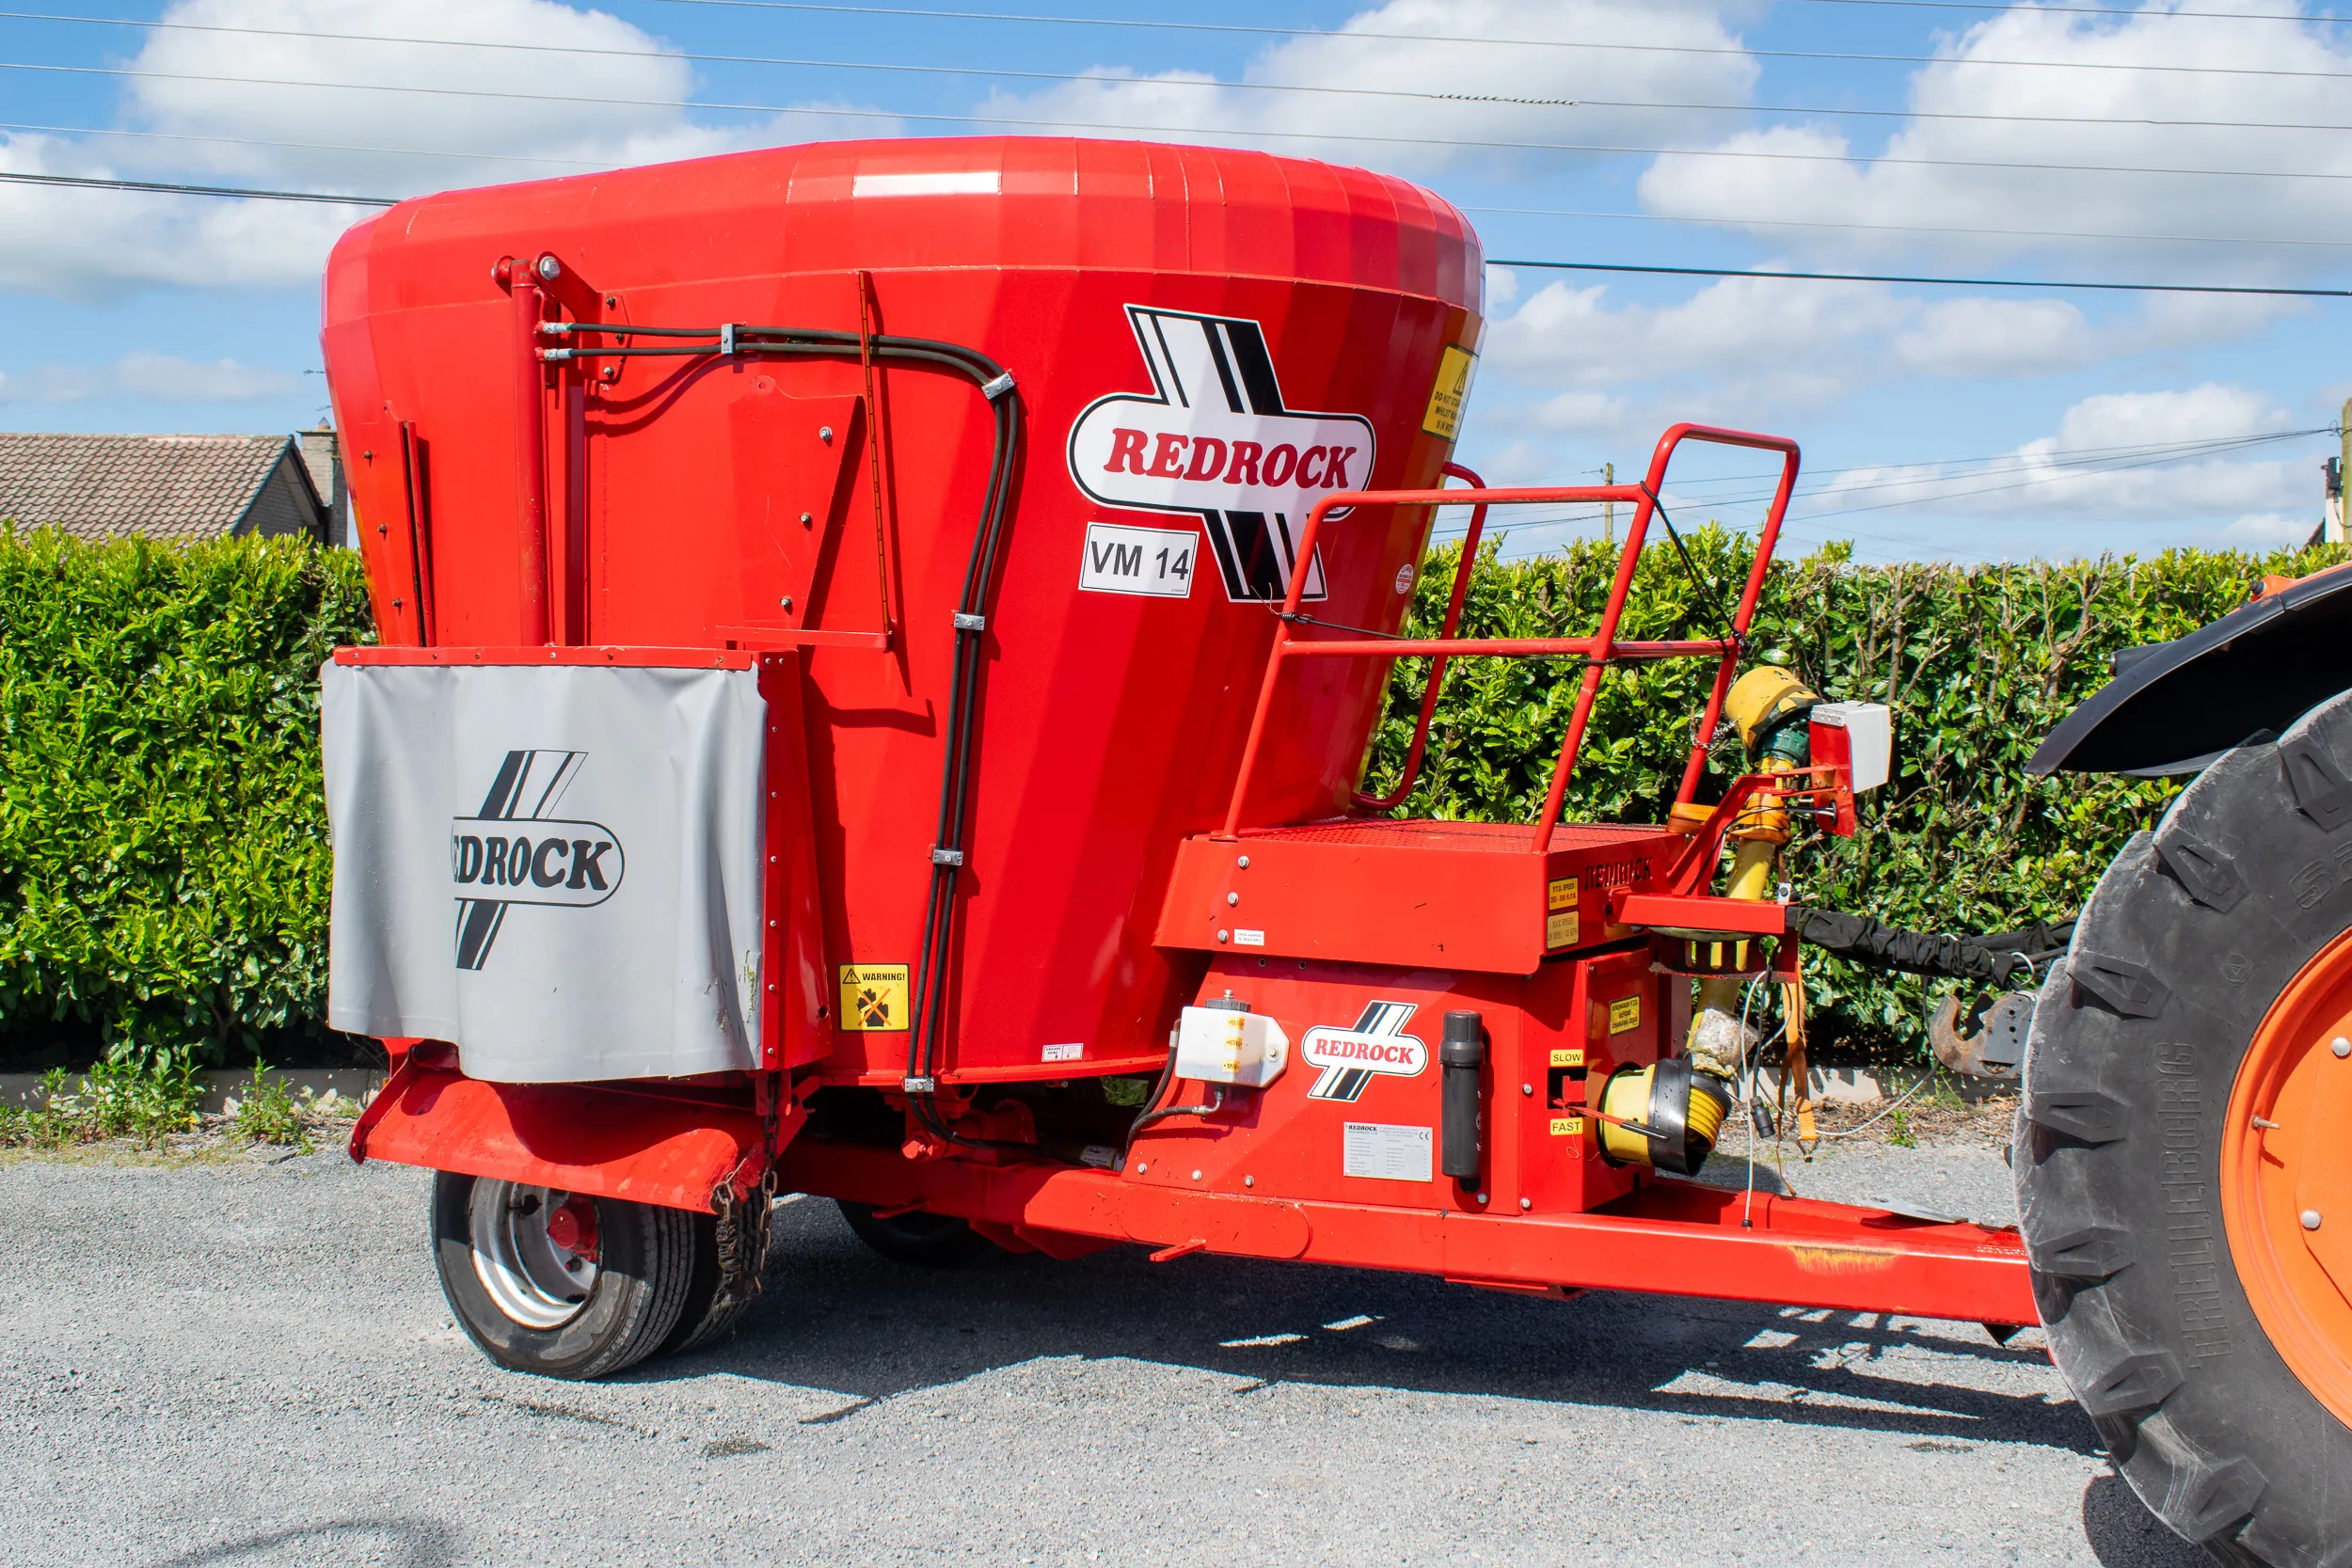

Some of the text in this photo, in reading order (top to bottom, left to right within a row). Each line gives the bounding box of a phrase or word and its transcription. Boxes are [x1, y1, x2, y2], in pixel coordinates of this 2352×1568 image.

[1104, 428, 1358, 489] REDROCK
[1091, 541, 1189, 580] VM 14
[1563, 882, 1575, 892] SPEED
[1584, 857, 1653, 891] REDROCK
[862, 973, 905, 981] WARNING!
[1314, 1038, 1414, 1064] REDROCK
[1552, 1053, 1581, 1062] SLOW
[1552, 1121, 1581, 1132] FAST
[2153, 1041, 2233, 1369] TRELLEBORG
